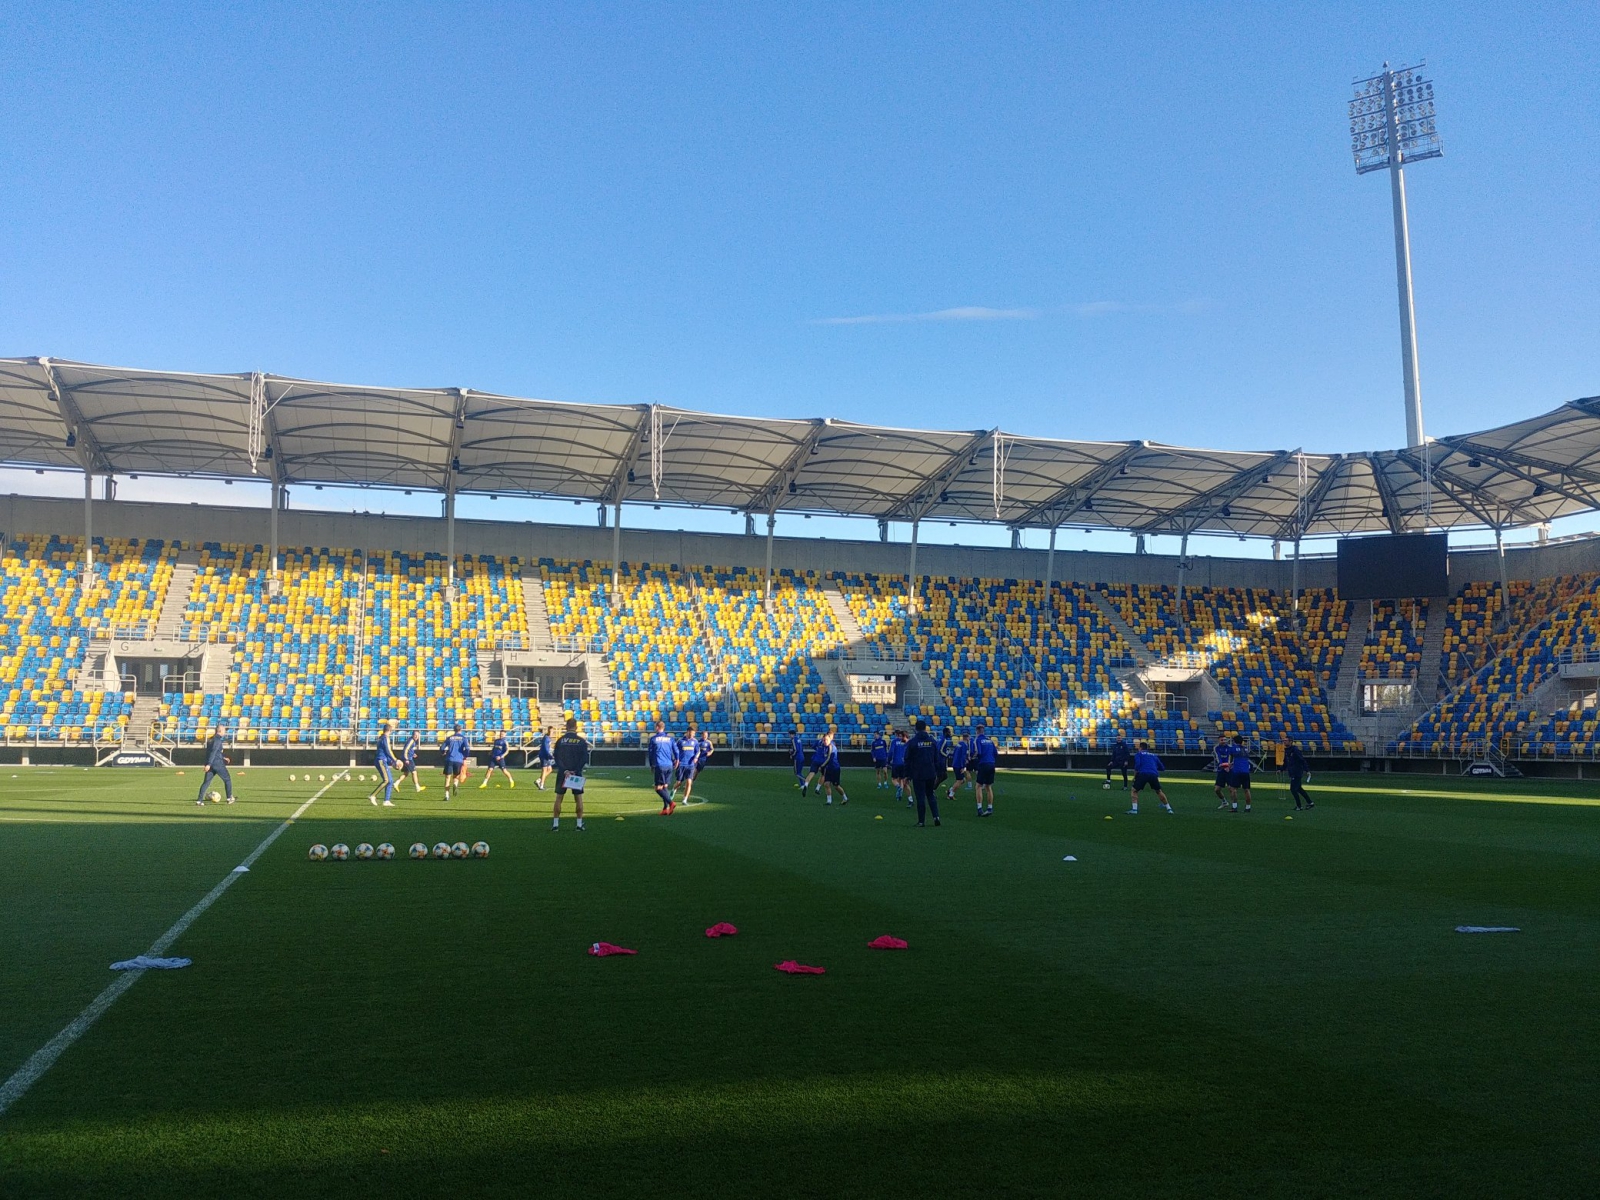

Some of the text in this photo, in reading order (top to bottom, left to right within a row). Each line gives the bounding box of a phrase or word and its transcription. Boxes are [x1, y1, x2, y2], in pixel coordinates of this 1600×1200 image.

[120, 641, 129, 652] G
[510, 652, 518, 661] H
[846, 661, 853, 669] H
